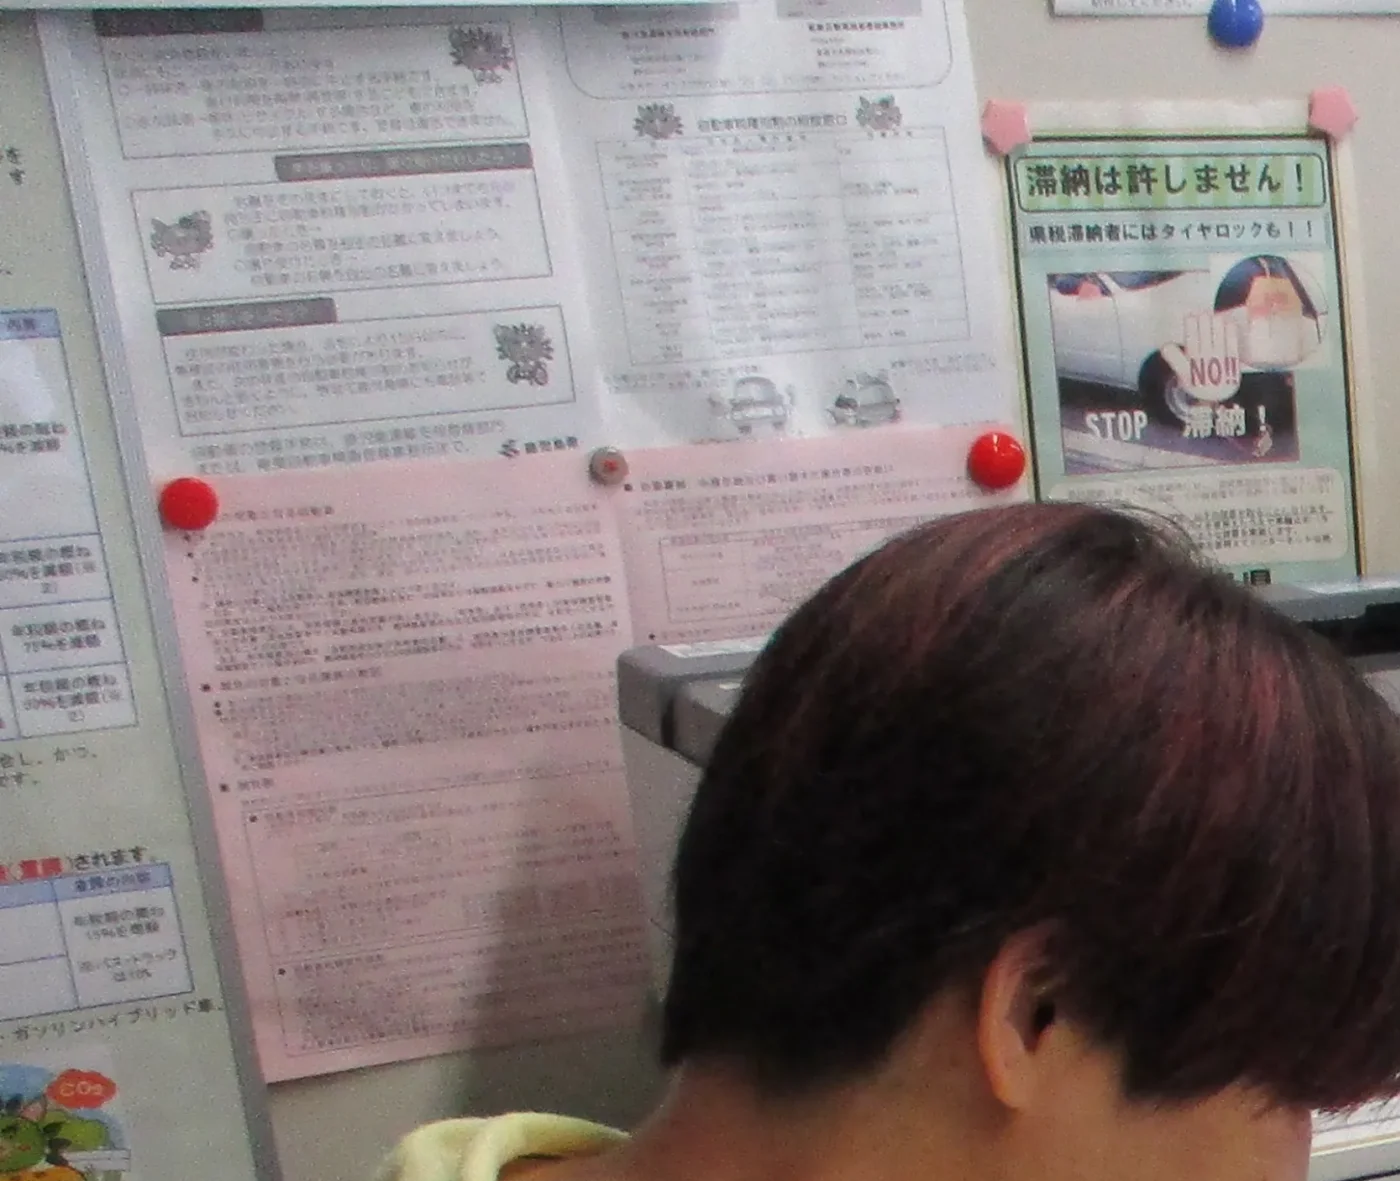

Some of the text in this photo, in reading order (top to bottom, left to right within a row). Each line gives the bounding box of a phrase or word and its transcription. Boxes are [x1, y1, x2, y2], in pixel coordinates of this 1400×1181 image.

[1026, 163, 1305, 198] 滞納は許しません！
[1086, 410, 1149, 442] STOP
